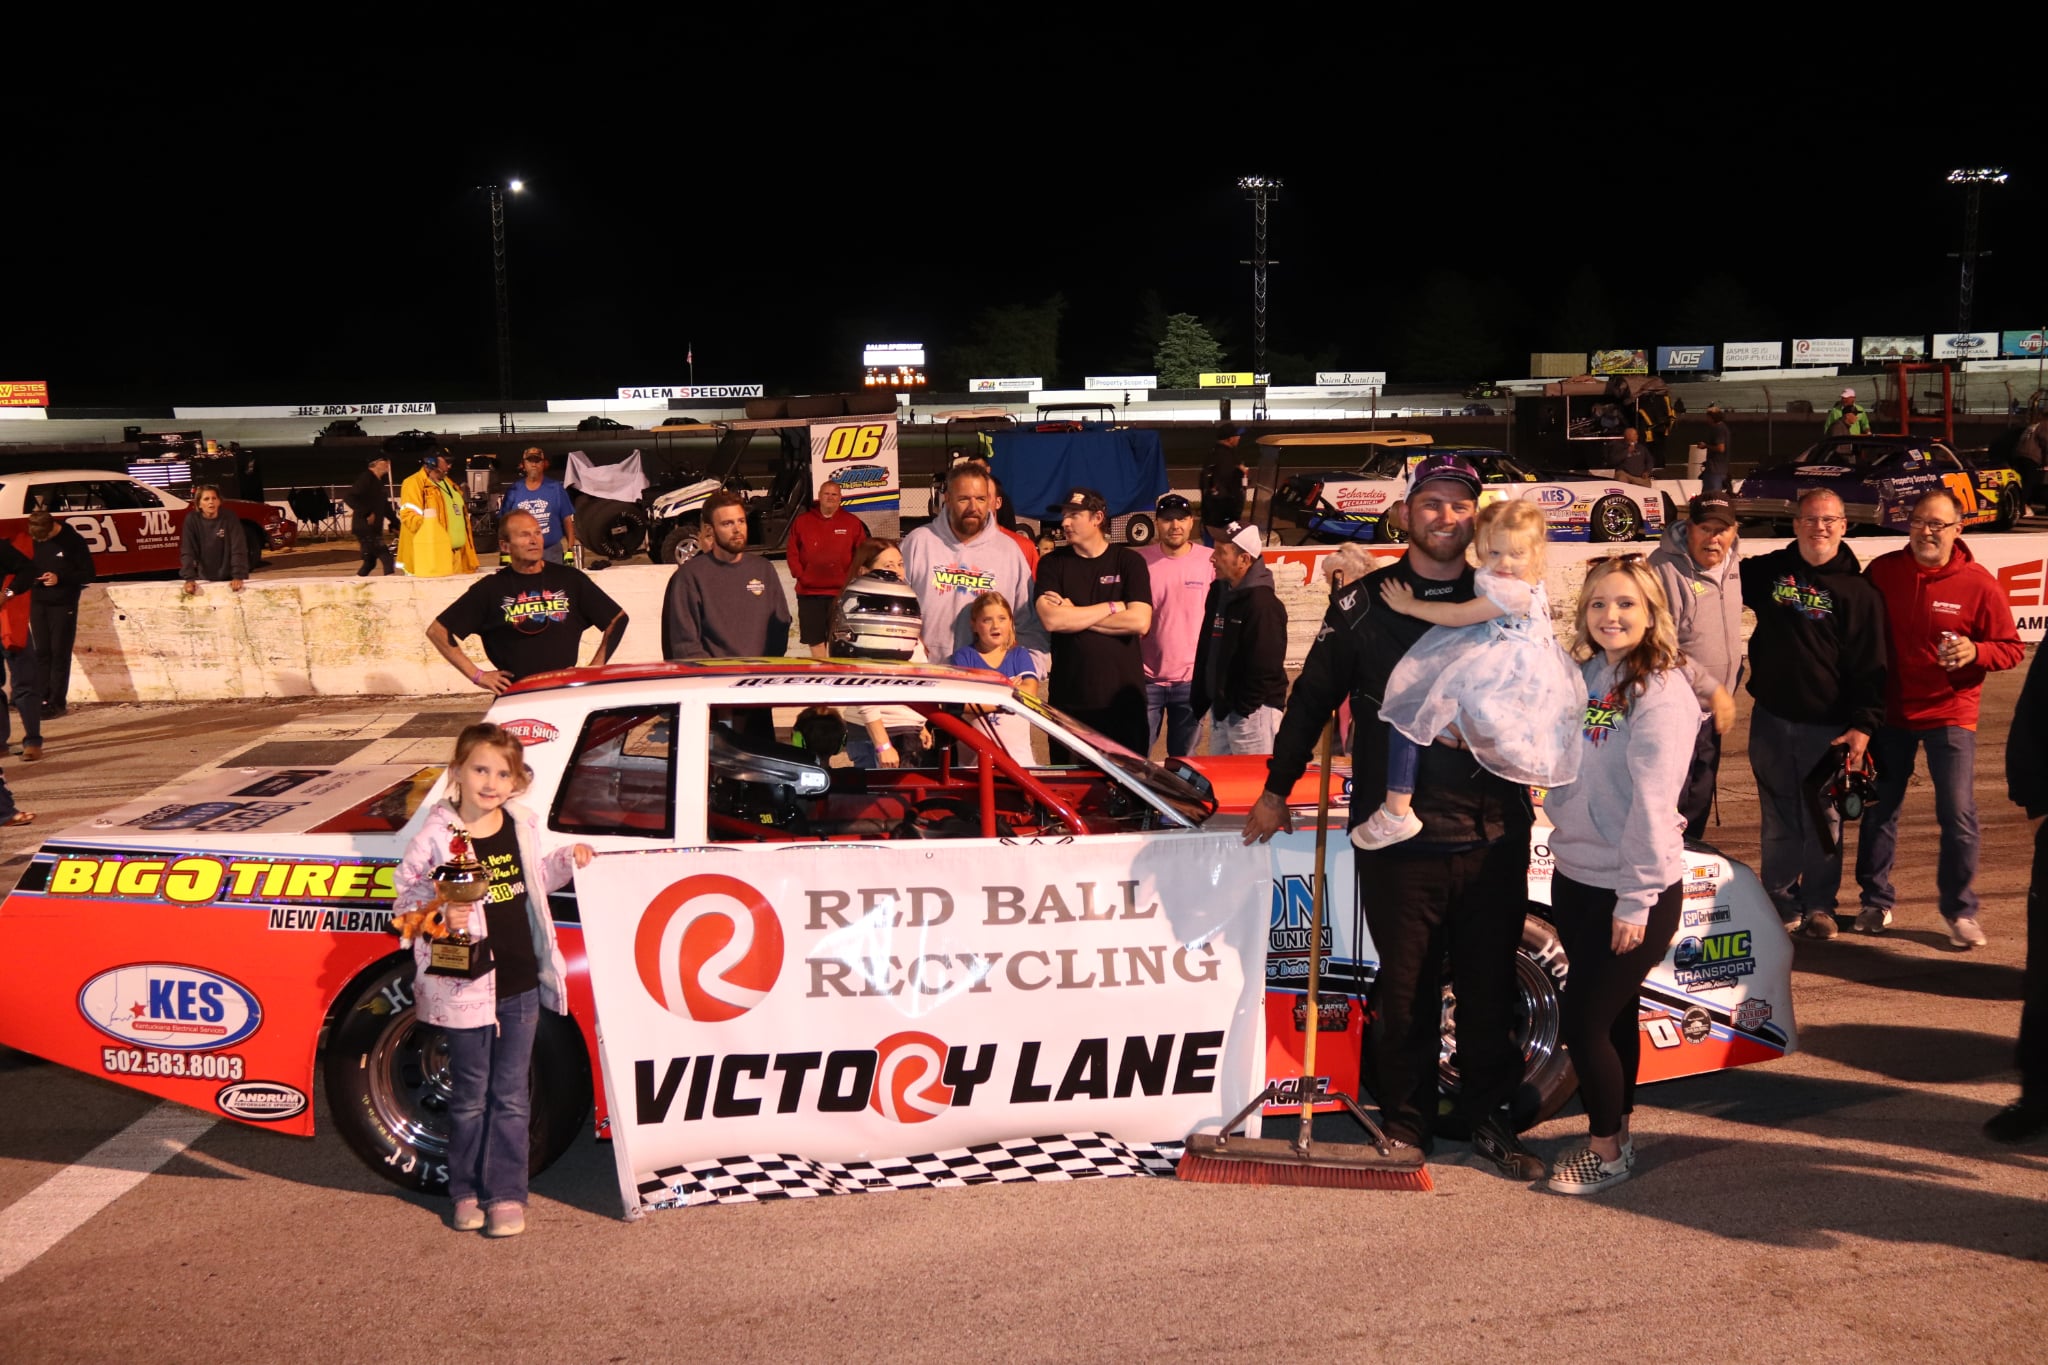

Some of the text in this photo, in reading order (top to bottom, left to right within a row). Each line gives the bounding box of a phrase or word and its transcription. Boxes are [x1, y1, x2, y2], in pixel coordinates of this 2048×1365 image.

[1669, 350, 1704, 365] NOS
[1216, 375, 1236, 384] BOYD
[1319, 373, 1341, 383] Salem
[1342, 373, 1370, 383] Rental
[12, 384, 46, 392] ESTES
[622, 386, 762, 399] SALEM SPEEDWAY
[322, 404, 348, 415] ARCA
[360, 403, 384, 415] RACE
[388, 403, 400, 413] AT
[401, 401, 432, 413] SALEM
[823, 424, 887, 463] 06
[1337, 488, 1386, 500] Schardein
[1542, 490, 1565, 502] KES
[138, 510, 176, 536] MR
[936, 572, 991, 589] WARE
[507, 601, 566, 616] WARE
[48, 859, 166, 895] BIG
[489, 883, 514, 903] 38
[804, 880, 1159, 931] RED BALL
[269, 909, 319, 930] NEW
[1684, 911, 1698, 926] SP
[1703, 933, 1748, 961] NIC
[804, 942, 1222, 998] RECYCLING
[1676, 961, 1754, 983] TRANSPORT
[150, 979, 224, 1022] KES
[135, 1023, 225, 1034] Kentuckiana Electrical Services
[104, 1048, 243, 1080] 502.583.8003
[634, 1031, 1226, 1125] VICTORY LANE
[226, 1090, 299, 1107] LANDRUM
